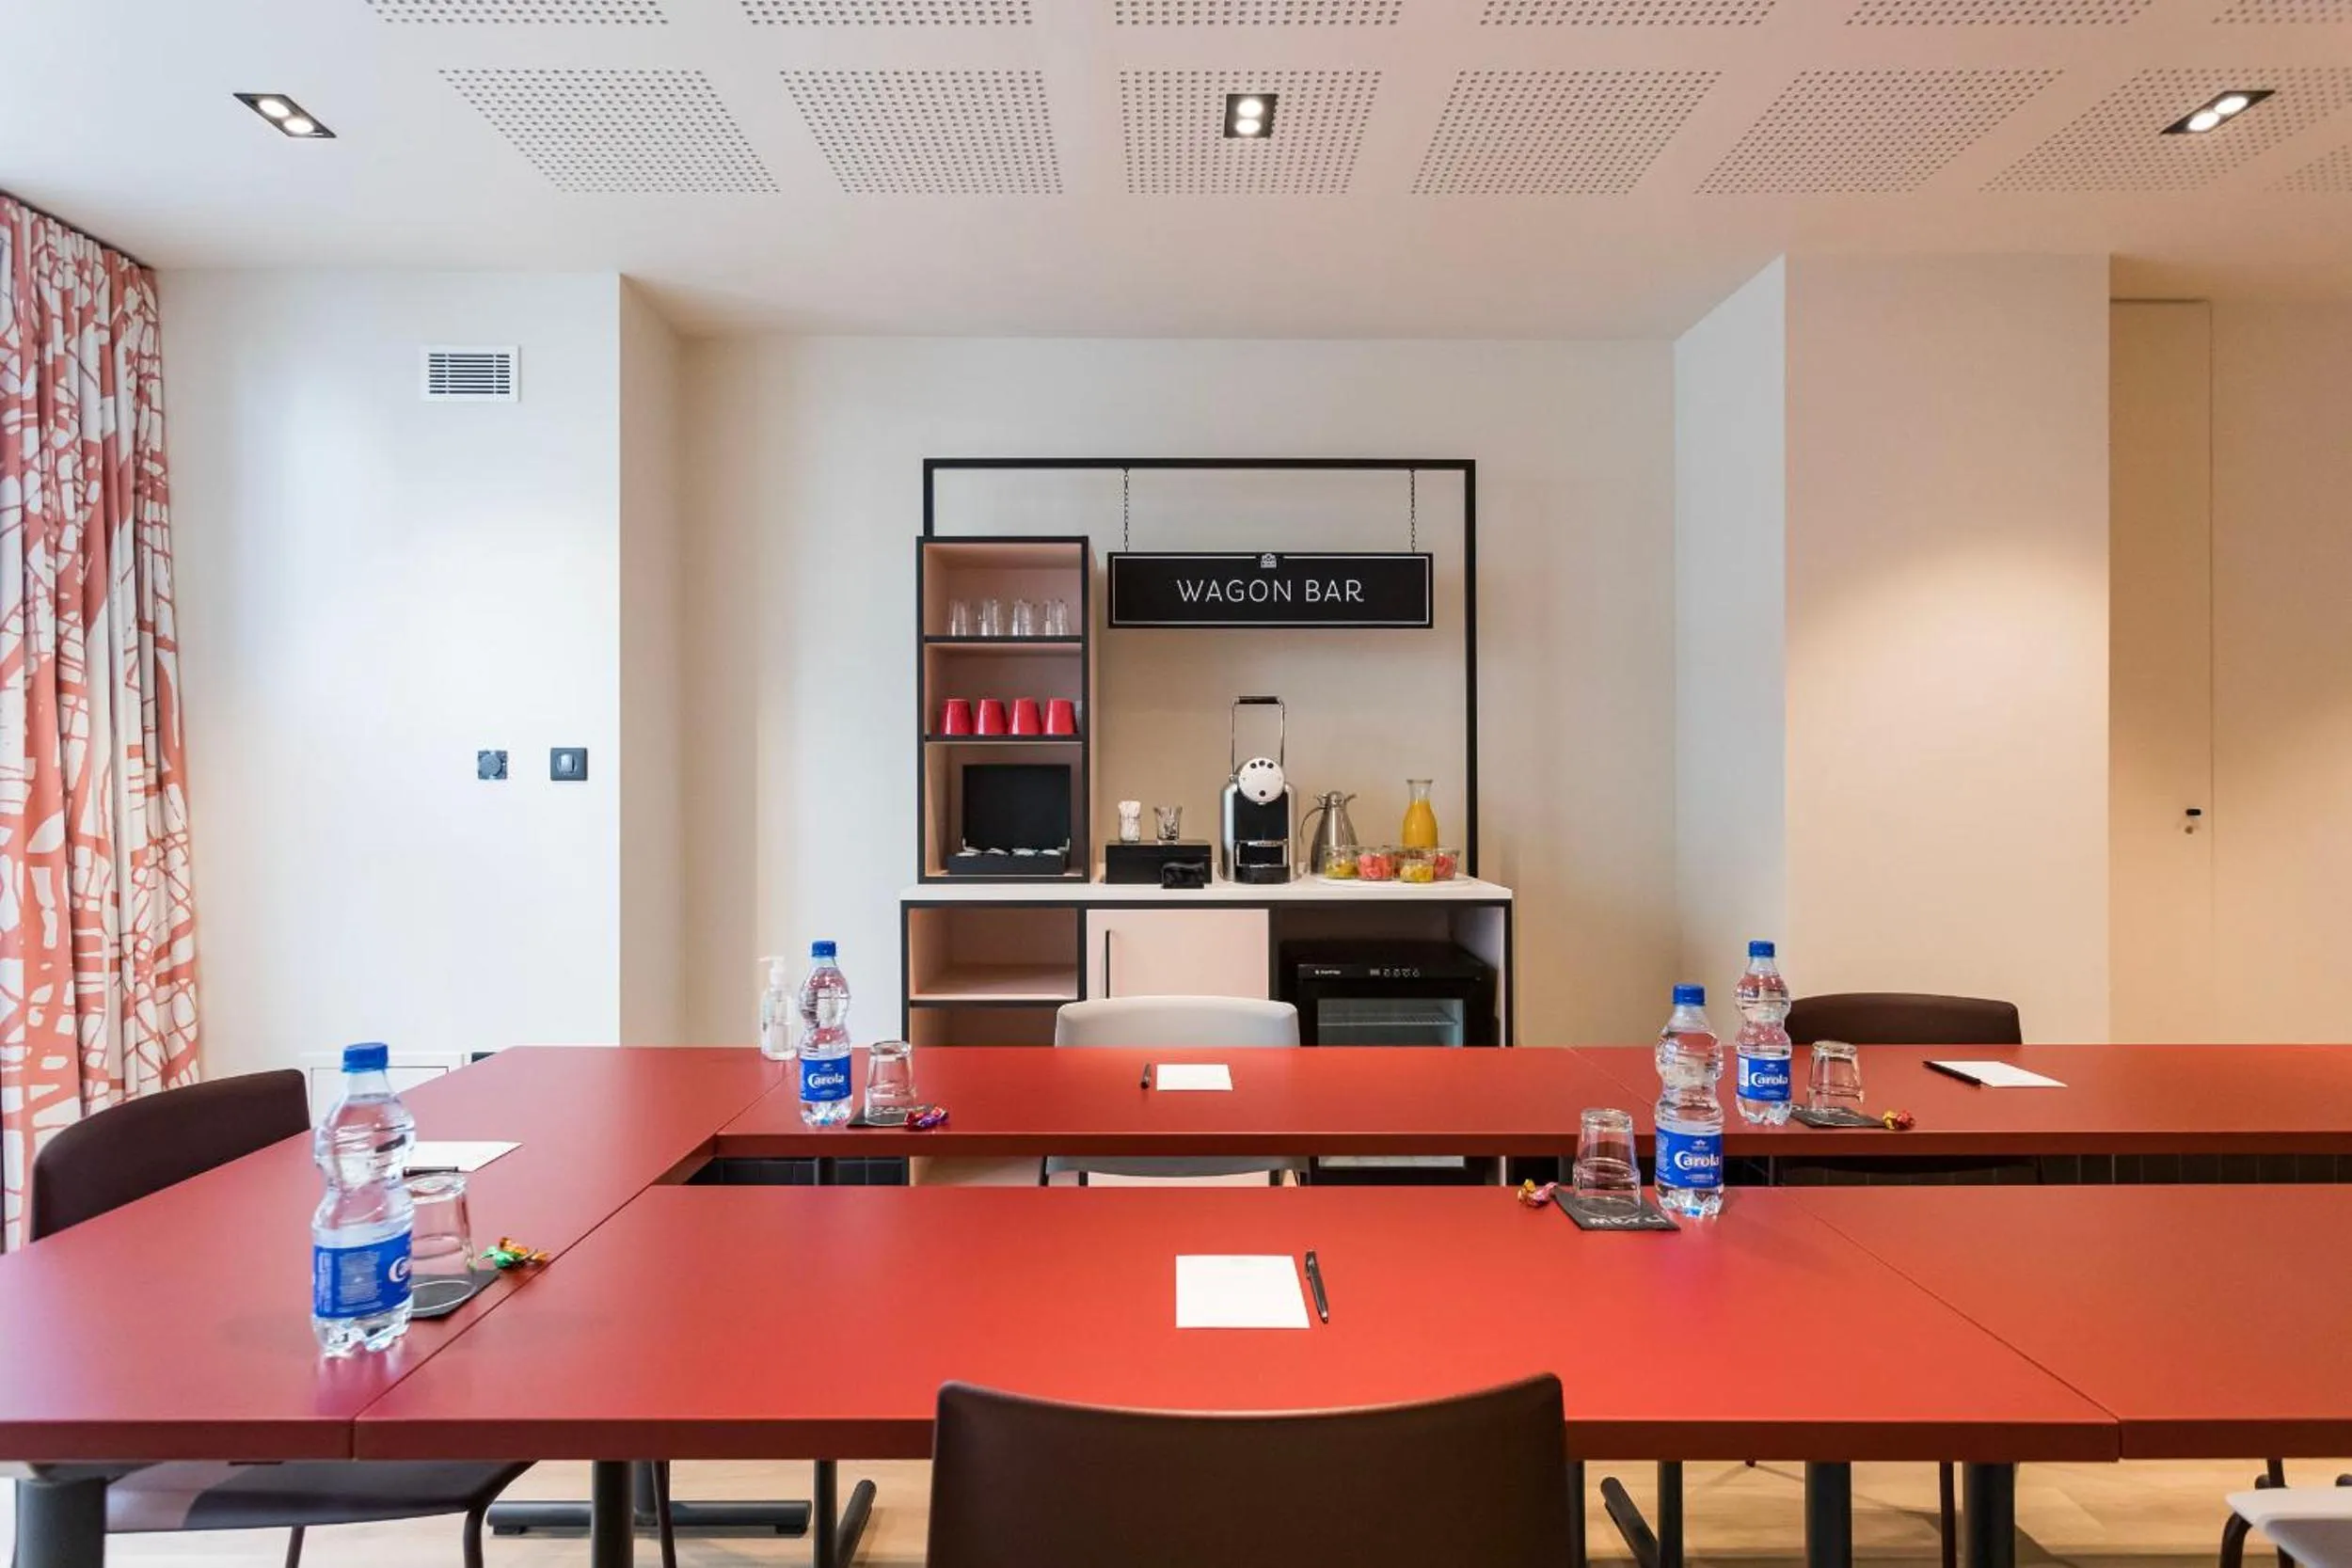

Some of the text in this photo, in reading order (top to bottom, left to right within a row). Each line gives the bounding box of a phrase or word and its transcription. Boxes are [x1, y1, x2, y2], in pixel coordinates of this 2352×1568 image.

[1176, 578, 1365, 603] WAGON BAR
[807, 1072, 845, 1088] Carola
[1750, 1071, 1788, 1088] Carola
[1674, 1149, 1720, 1171] Carola
